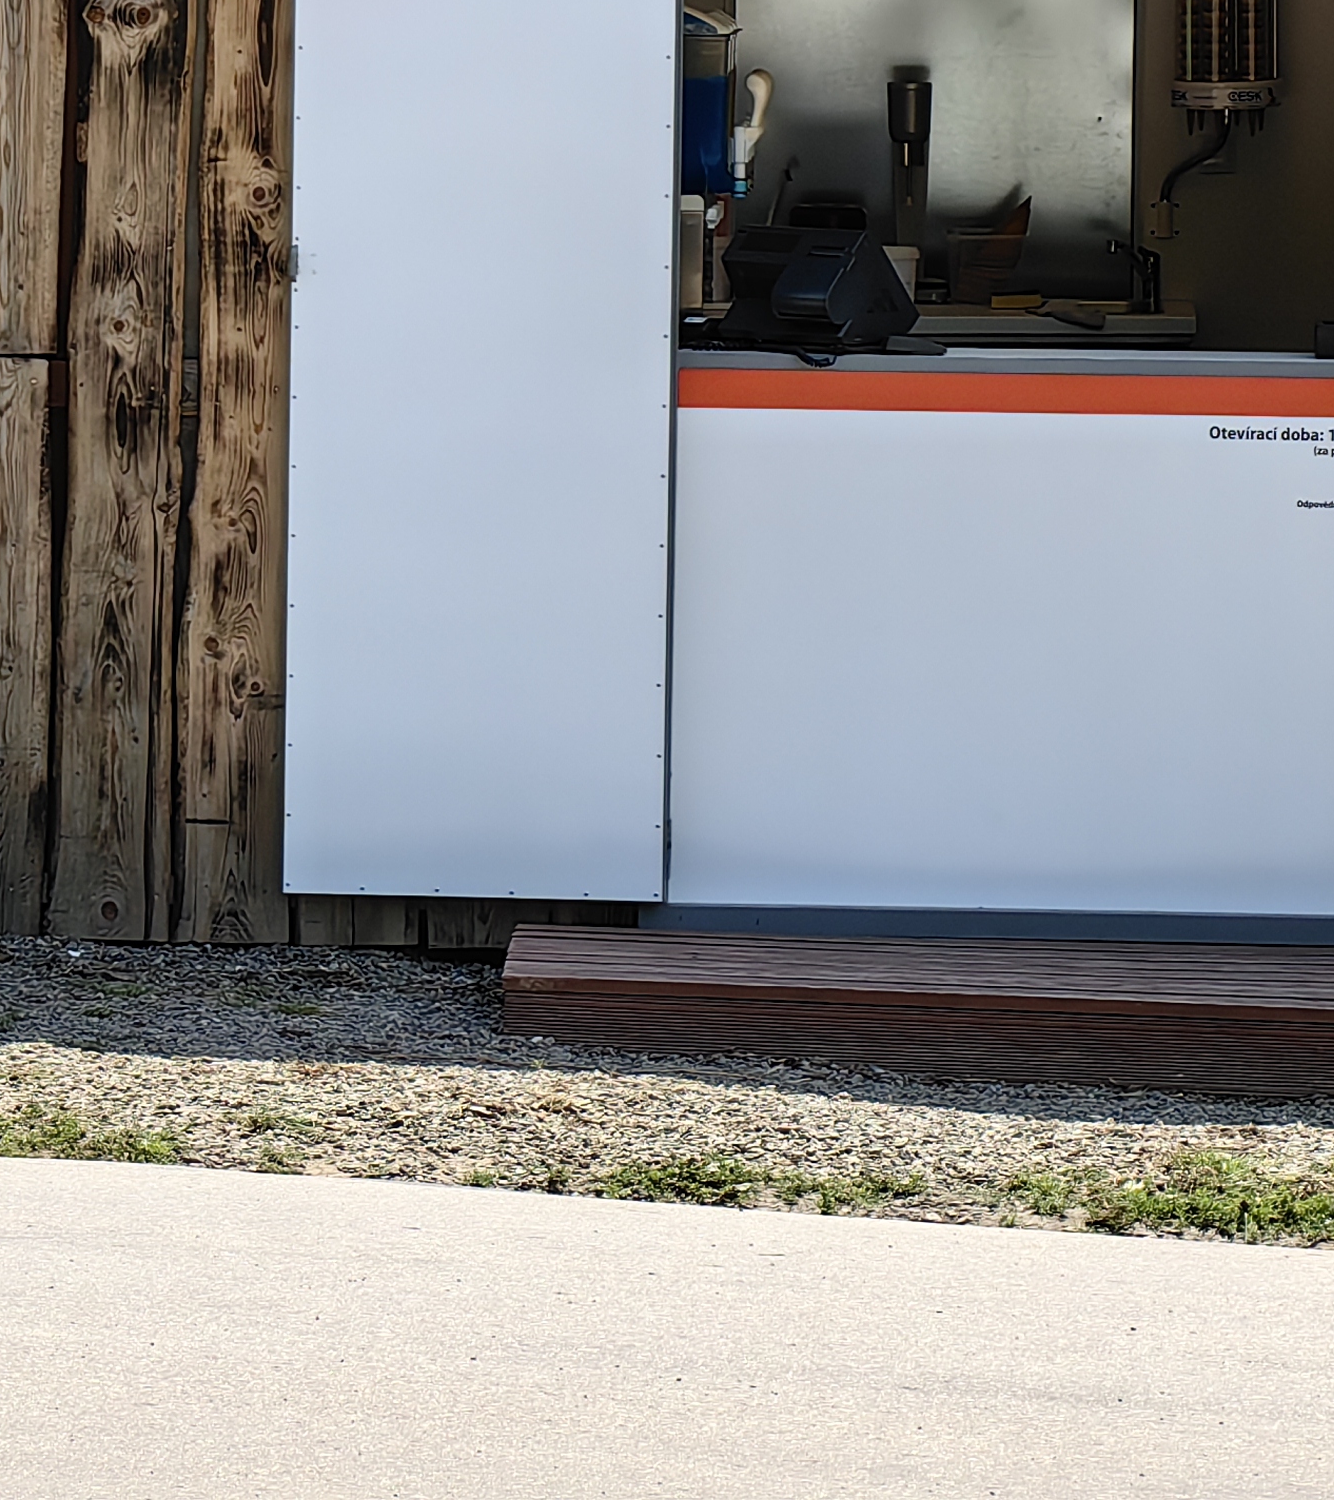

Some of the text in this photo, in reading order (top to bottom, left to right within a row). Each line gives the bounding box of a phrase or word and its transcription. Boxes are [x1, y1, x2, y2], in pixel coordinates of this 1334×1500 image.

[1209, 425, 1277, 441] Otevírací
[1281, 427, 1324, 442] doba:
[1313, 446, 1328, 457] (za
